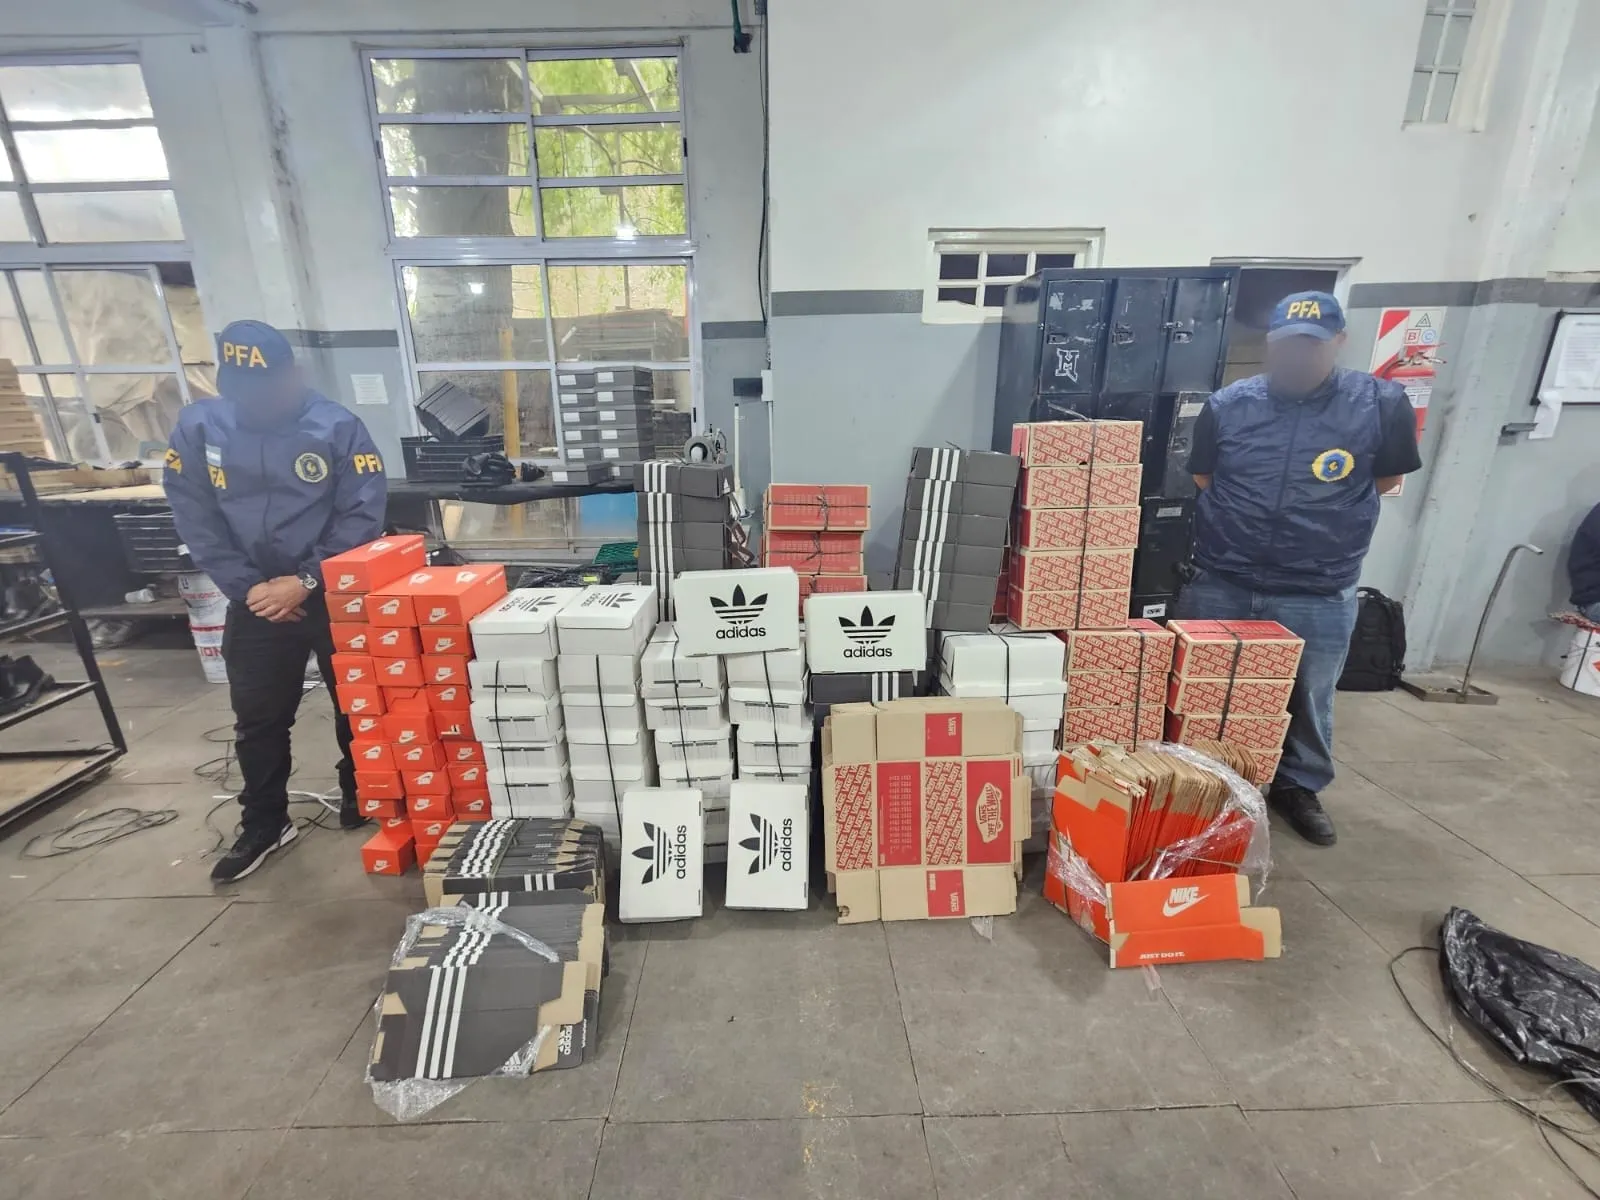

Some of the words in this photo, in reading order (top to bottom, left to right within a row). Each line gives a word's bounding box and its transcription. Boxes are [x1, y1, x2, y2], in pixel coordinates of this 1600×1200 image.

[1287, 301, 1321, 319] PFA
[223, 341, 268, 368] PFA
[208, 464, 227, 490] FA
[715, 624, 767, 640] adidas
[843, 645, 893, 659] adidas
[979, 804, 987, 825] VANS
[987, 807, 997, 822] THE
[674, 825, 687, 879] adidas
[780, 818, 793, 872] adidas
[1169, 886, 1200, 904] NIKE
